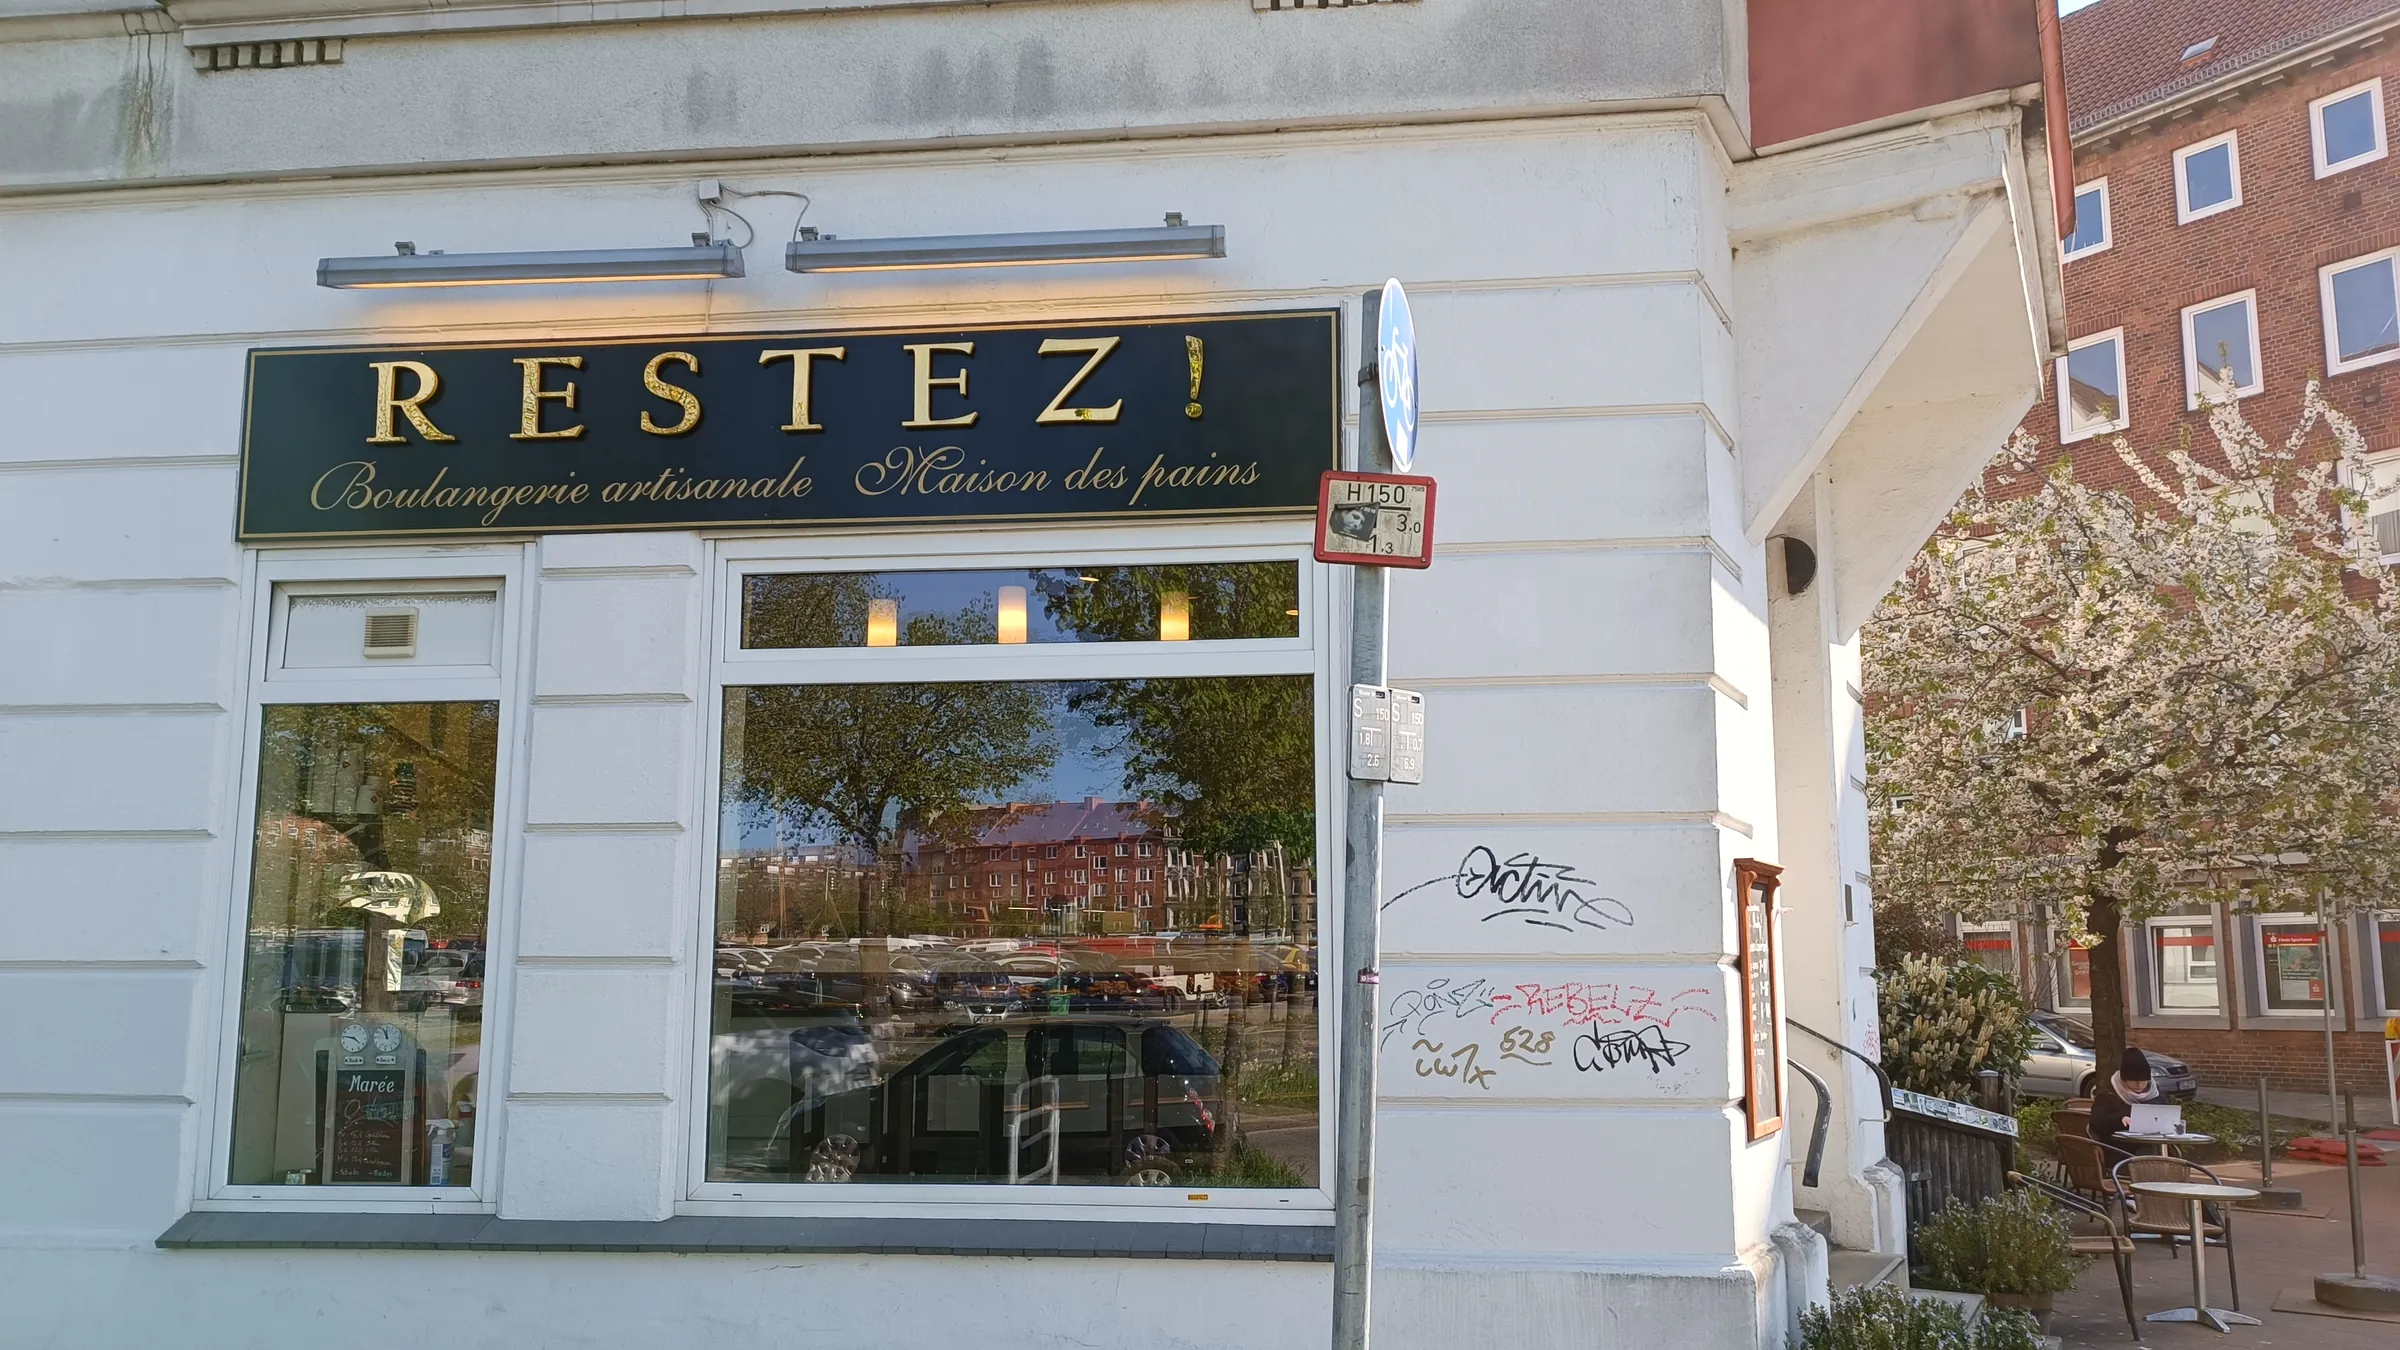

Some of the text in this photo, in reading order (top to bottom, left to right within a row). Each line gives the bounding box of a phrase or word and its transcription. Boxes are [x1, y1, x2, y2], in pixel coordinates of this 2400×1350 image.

[366, 335, 1205, 445] RESTEZ!
[311, 445, 1261, 526] Boulangerie artisanale Maison des pains
[1354, 697, 1390, 721] S 150
[1392, 702, 1424, 725] S 150
[348, 1075, 395, 1092] Marée
